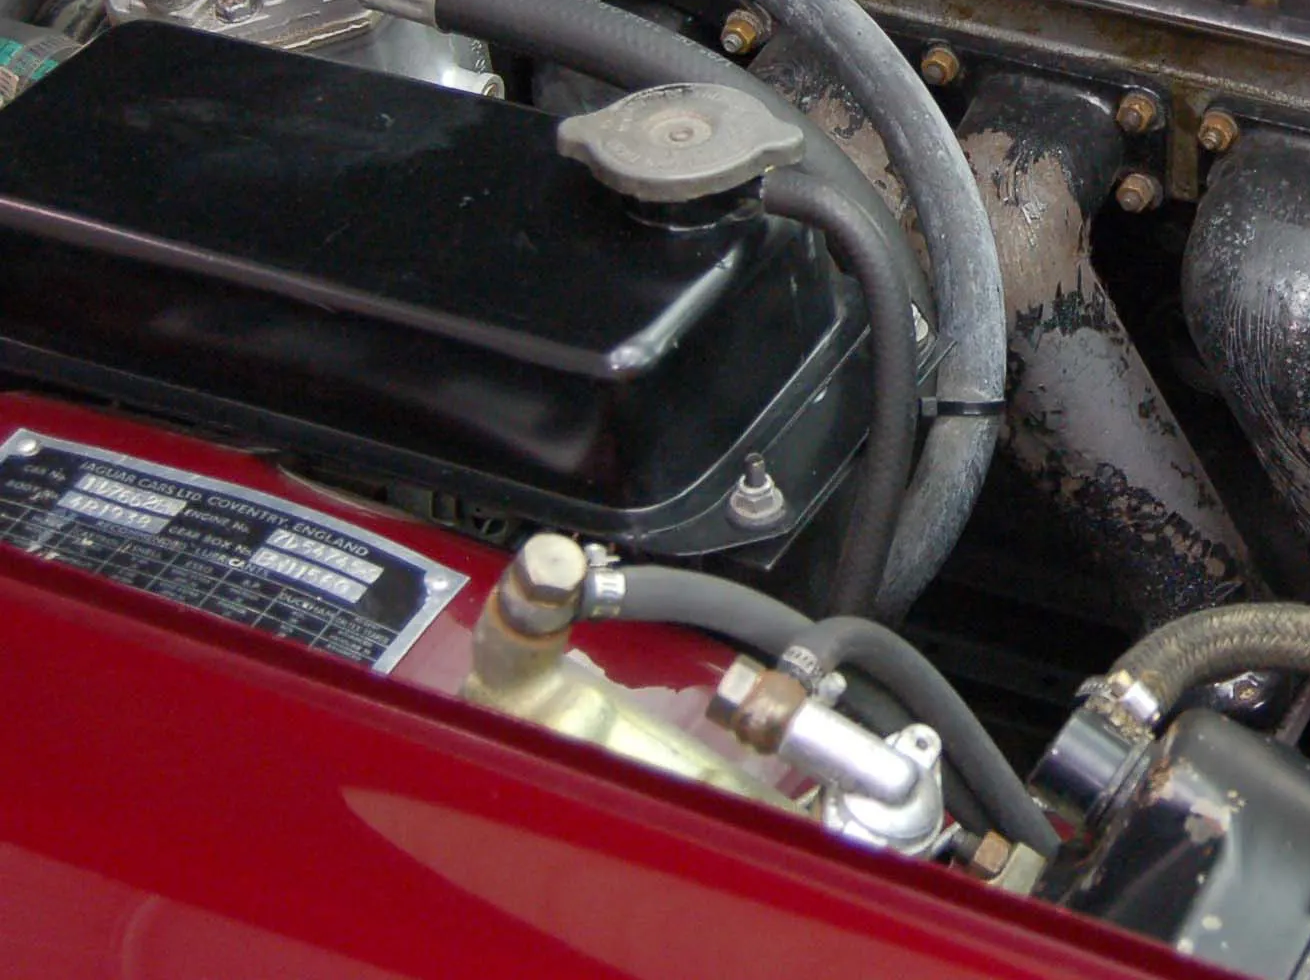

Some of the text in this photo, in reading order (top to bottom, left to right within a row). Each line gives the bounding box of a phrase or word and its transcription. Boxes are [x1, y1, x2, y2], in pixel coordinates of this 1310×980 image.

[79, 461, 137, 484] JAGUAR
[138, 478, 175, 495] CARS
[293, 522, 370, 556] ENGLAND
